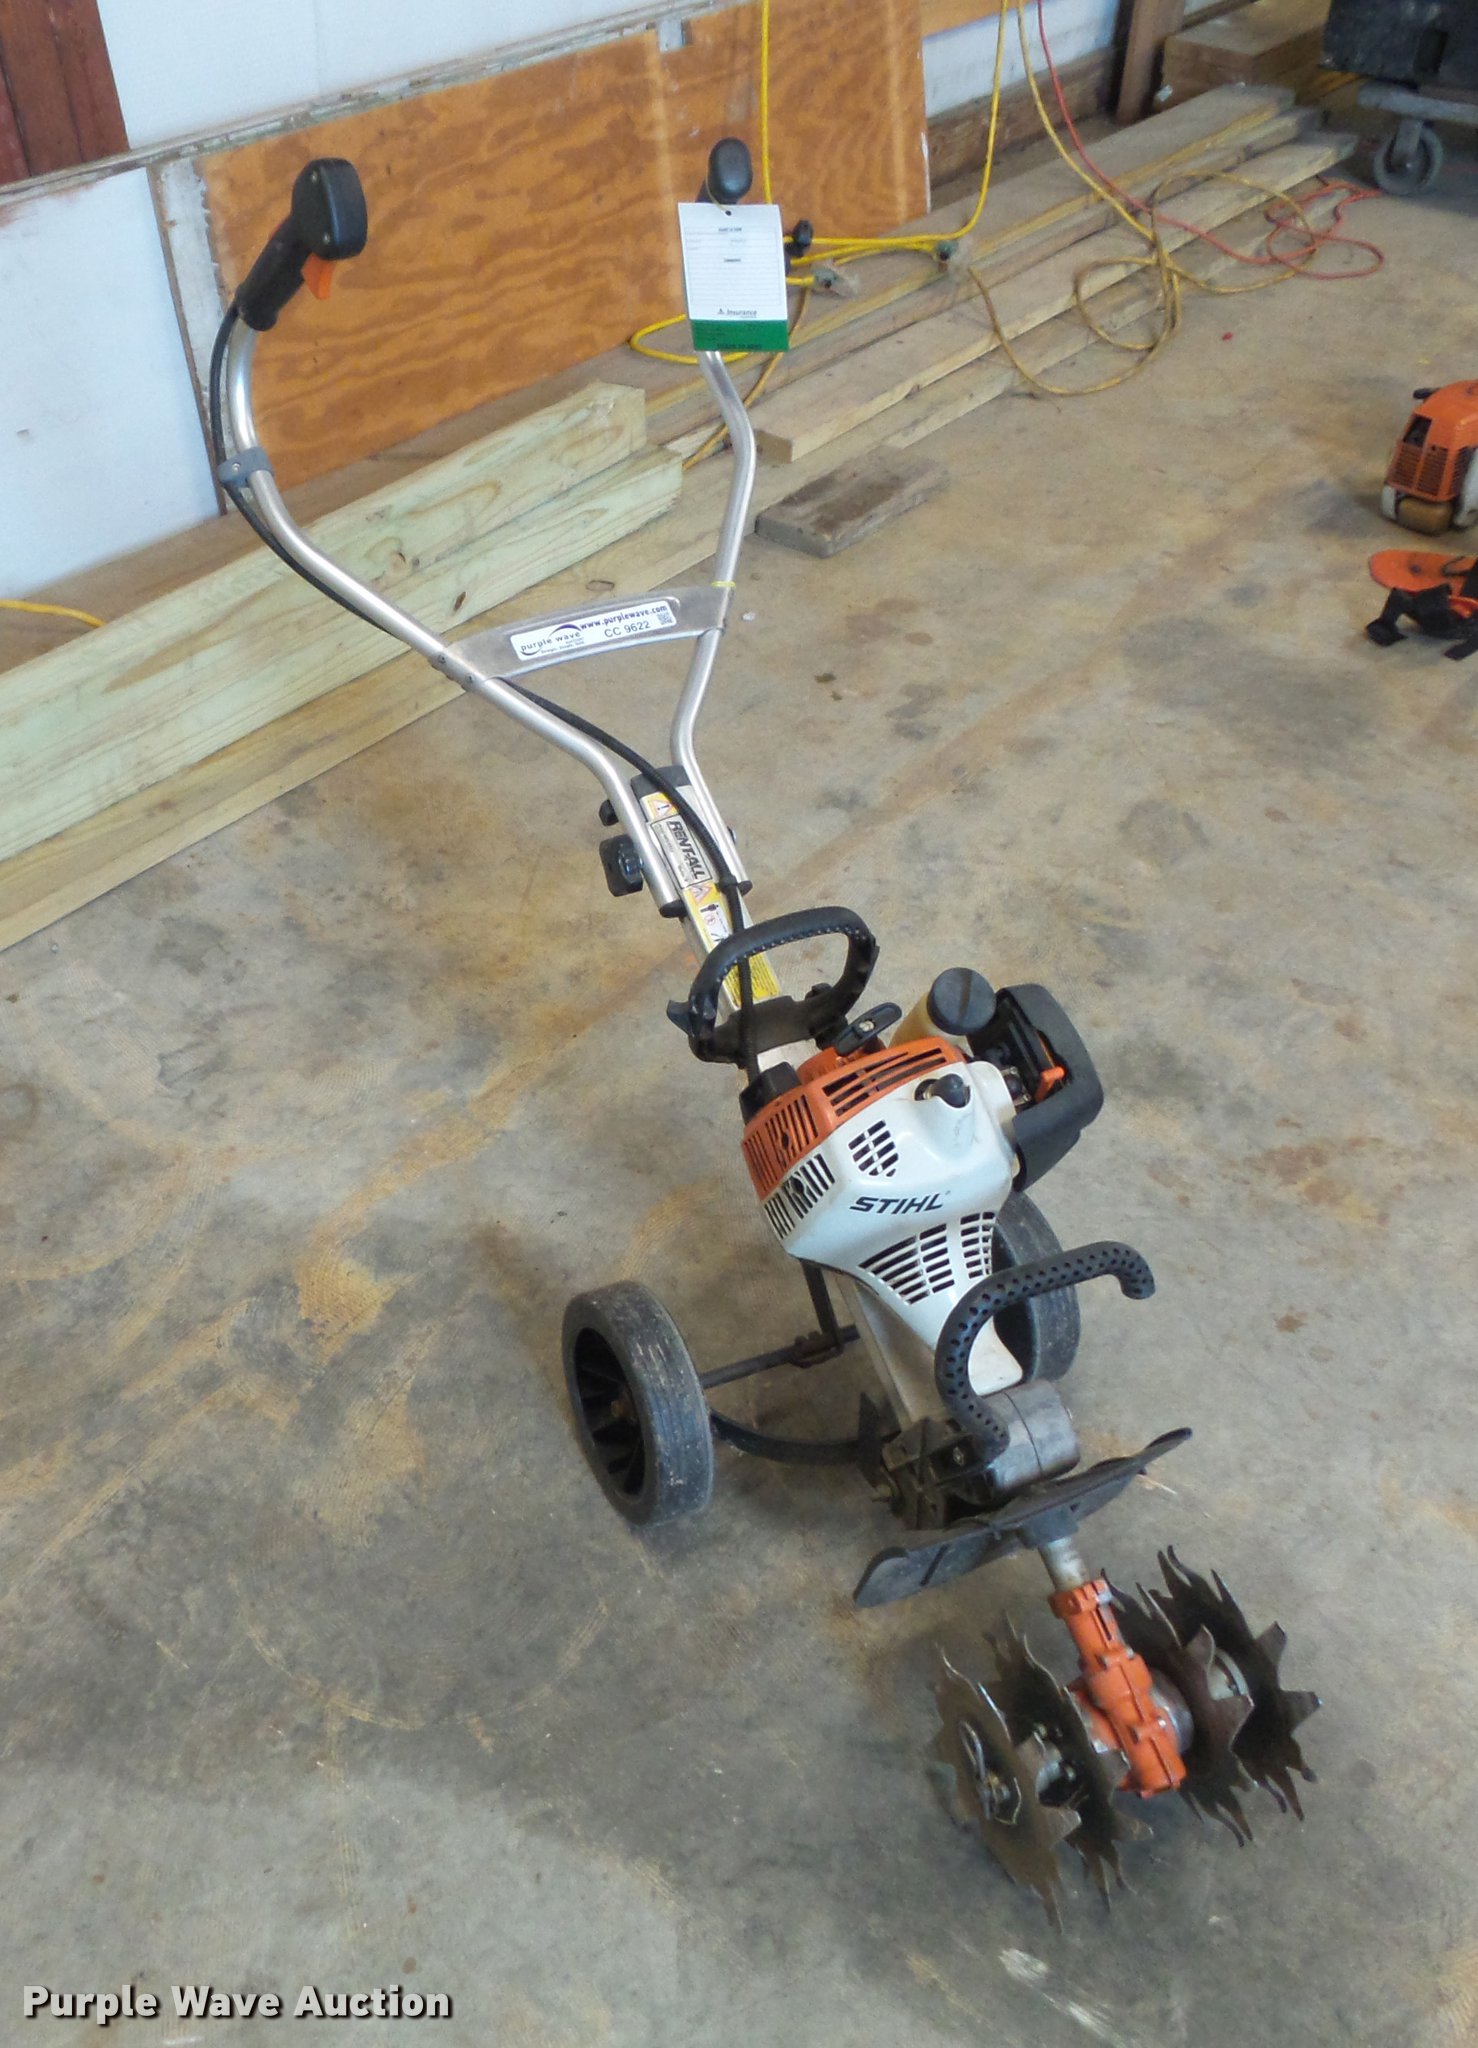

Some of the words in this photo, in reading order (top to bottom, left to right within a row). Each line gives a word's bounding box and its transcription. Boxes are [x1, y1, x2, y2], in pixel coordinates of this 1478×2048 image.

[580, 605, 668, 630] www.purplewave.com
[604, 626, 622, 638] CC
[624, 621, 651, 634] 9622
[520, 635, 553, 652] purple
[555, 631, 581, 645] wave
[849, 1193, 944, 1216] STIHL
